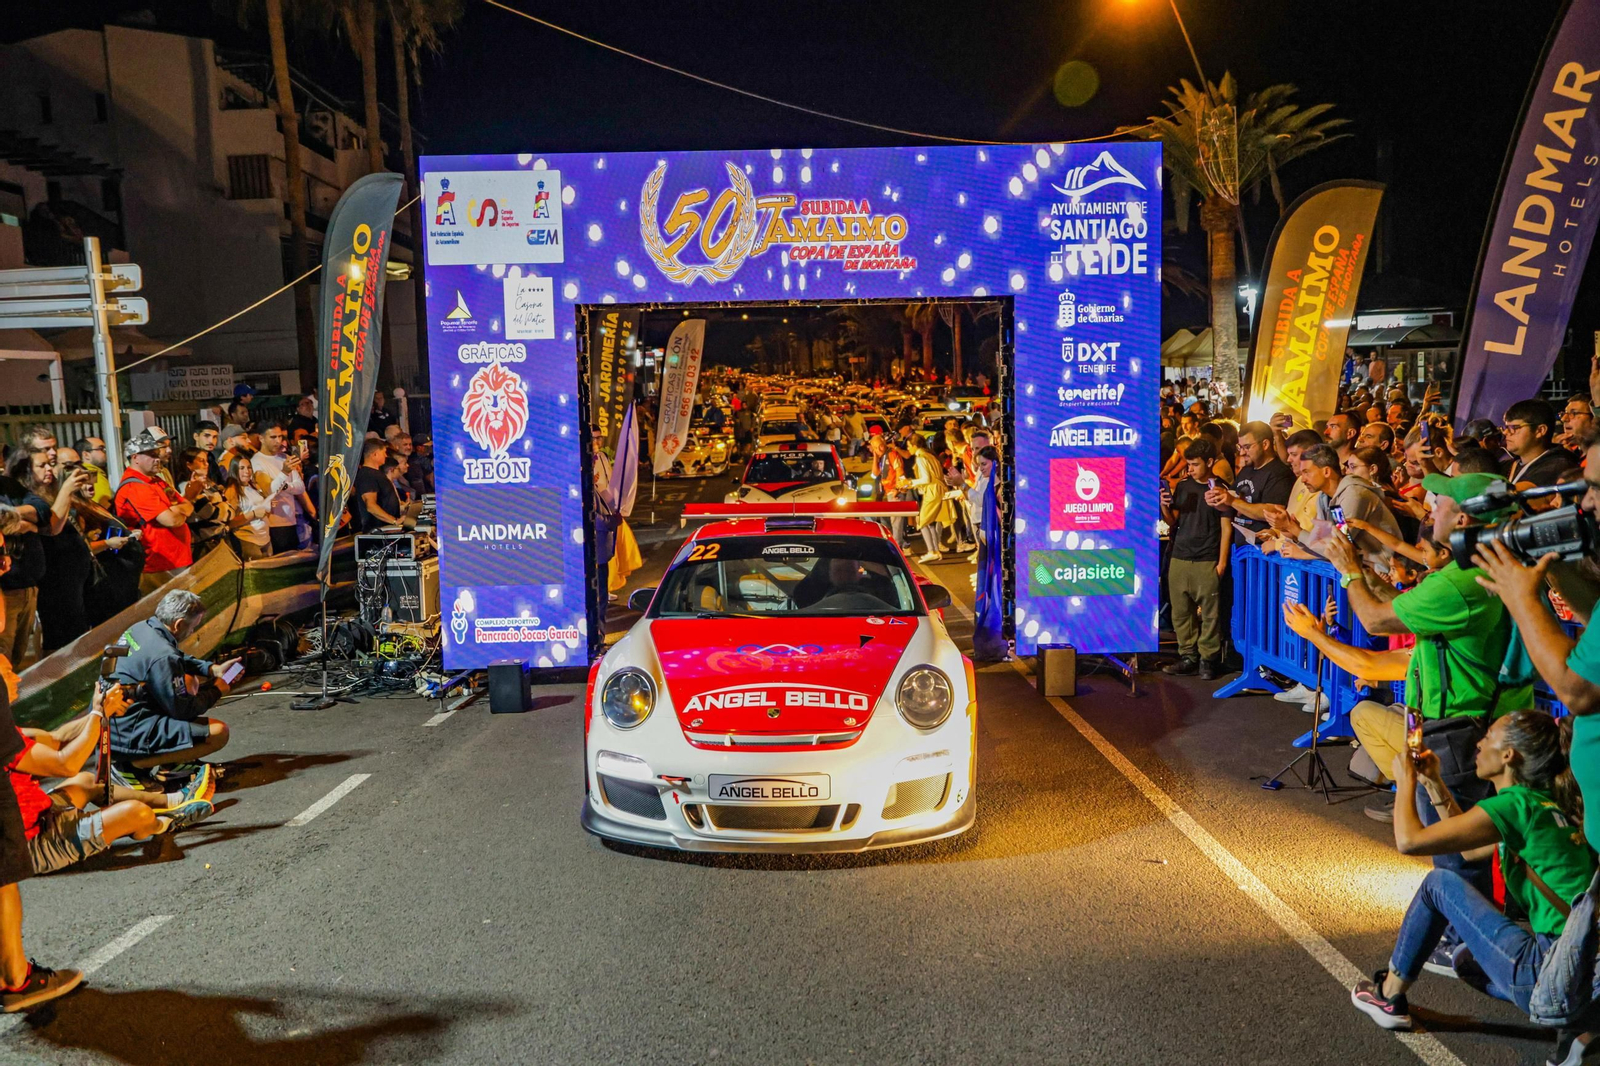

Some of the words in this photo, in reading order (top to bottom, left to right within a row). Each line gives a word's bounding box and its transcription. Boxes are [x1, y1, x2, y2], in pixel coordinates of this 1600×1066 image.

[801, 199, 856, 216] SUBIDA
[857, 199, 870, 215] A
[1484, 61, 1600, 356] LANDMAR
[1553, 154, 1599, 277] HOTELS
[663, 189, 743, 260] 50
[750, 195, 908, 257] TAMAIMO
[1050, 218, 1148, 240] SANTIAGO
[789, 244, 826, 260] COPA
[827, 244, 846, 259] DE
[847, 242, 899, 258] ESPAÑA
[1065, 242, 1147, 275] TEIDE
[844, 259, 858, 270] DE
[860, 256, 917, 270] MONTAÑA
[1341, 233, 1364, 292] MONTAÑA
[336, 275, 347, 287] A
[1328, 248, 1350, 302] ESPAÑA
[1078, 304, 1116, 313] Gobierno
[1337, 294, 1346, 309] DE
[360, 308, 371, 329] DE
[1078, 314, 1088, 323] de
[1088, 314, 1124, 323] Canarias
[1271, 286, 1298, 358] SUBIDA
[1286, 268, 1303, 283] A
[1324, 302, 1336, 326] DE
[325, 224, 372, 448] TAMAIMO
[330, 293, 345, 370] SUBIDA
[356, 332, 368, 371] COPA
[460, 344, 524, 360] GRÁFICAS
[600, 313, 619, 403] JARDINERÍA
[690, 348, 699, 362] 42
[1078, 342, 1121, 362] DXT
[686, 365, 696, 378] 03
[1078, 364, 1116, 373] TENEIFE
[664, 372, 676, 424] GRÁFICAS
[670, 336, 682, 369] LÓN
[684, 381, 694, 394] 59
[680, 398, 690, 417] 656
[1050, 429, 1093, 446] ANGEL
[1094, 428, 1133, 445] BELLO
[466, 455, 528, 480] LEÓN
[1063, 503, 1088, 513] JUEGO
[1089, 502, 1114, 513] LIMPIO
[458, 524, 547, 542] LANDMAR
[687, 543, 721, 562] 22
[761, 547, 788, 555] ANGEL
[1054, 564, 1125, 583] cajasiete
[507, 618, 539, 626] DEPORTIVO
[476, 628, 520, 642] Pancracio
[522, 628, 546, 640] Socas
[548, 626, 578, 639] García
[682, 692, 777, 714] ANGEL
[785, 690, 869, 710] BELLO
[718, 786, 769, 799] ANGEL
[771, 786, 819, 799] BELLO
